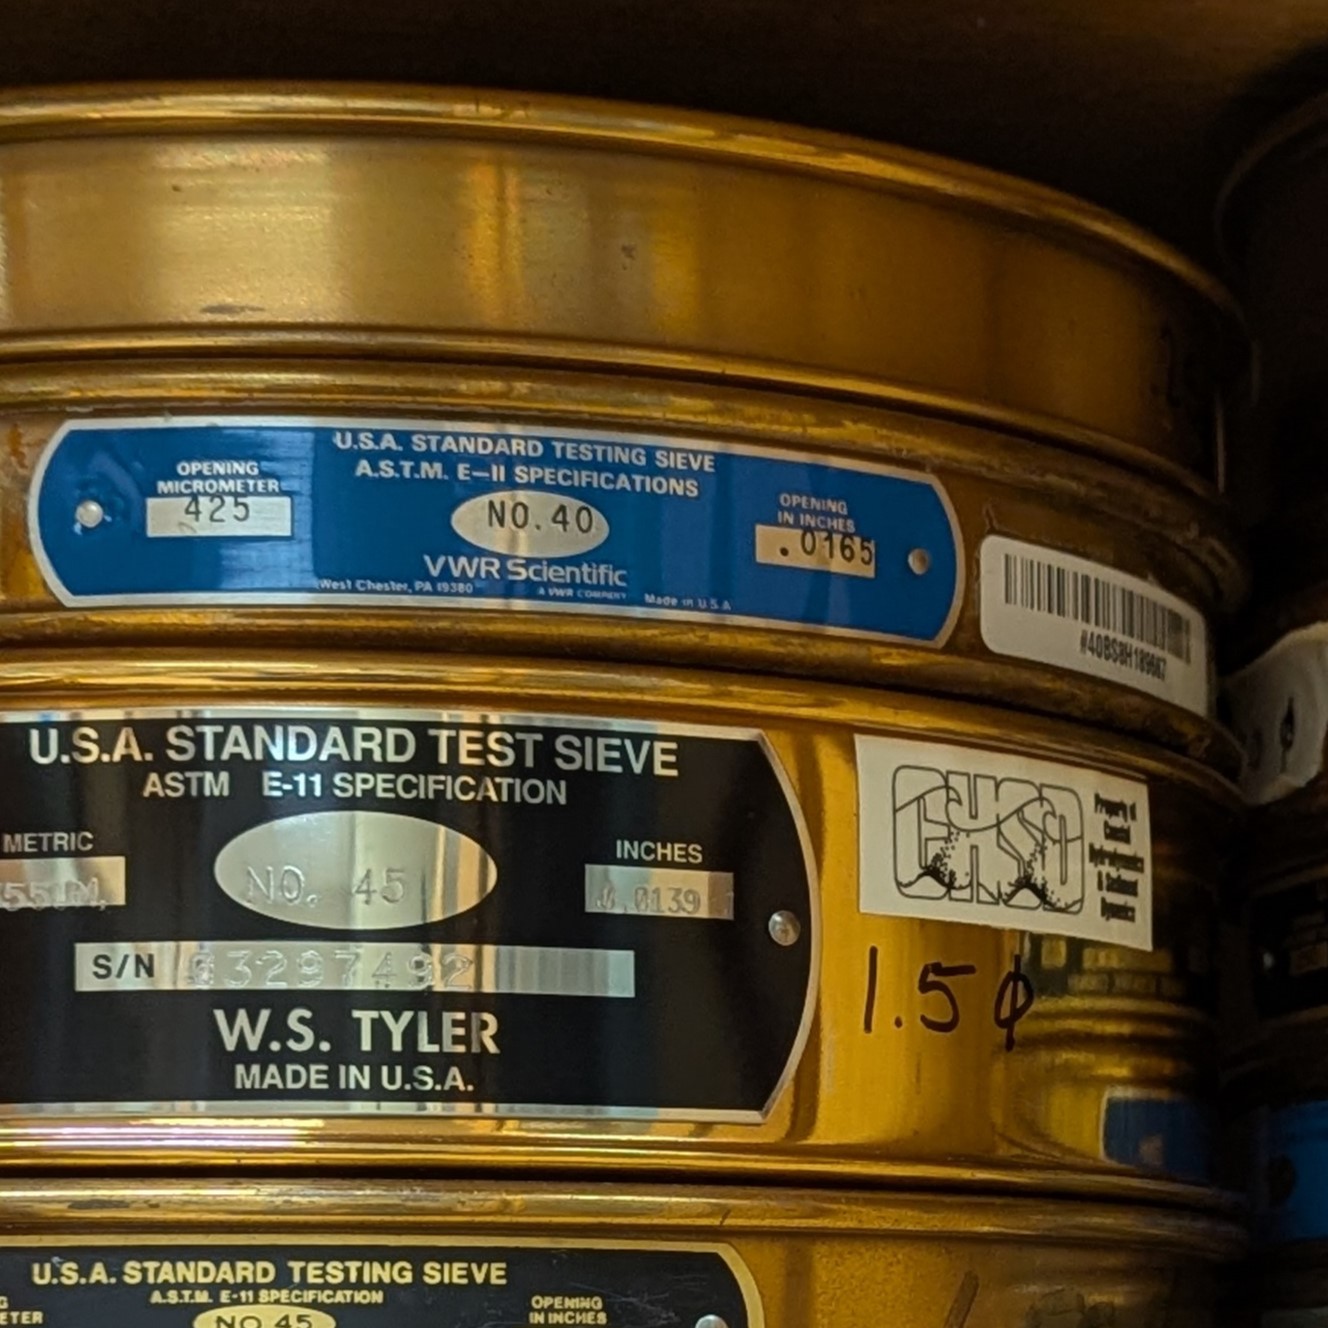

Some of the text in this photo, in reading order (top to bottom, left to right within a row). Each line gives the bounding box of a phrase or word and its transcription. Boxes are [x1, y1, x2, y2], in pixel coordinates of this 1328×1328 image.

[333, 432, 716, 473] U.S.A. STANDARD TESTING SIEVE
[176, 461, 260, 476] OPENING
[355, 460, 699, 498] A.S.T.M. SPECIFICATIONS
[156, 479, 280, 494] MICROMETER
[184, 497, 251, 524] 425
[779, 493, 849, 516] OPENING
[778, 510, 856, 535] IN INCHES
[423, 554, 628, 588] VWR Scientific
[414, 580, 433, 592] PA
[29, 725, 680, 778] U.S.A. STANDARD TEST SIEVE
[142, 771, 568, 806] ASTM E-11 SPECIFICATION
[2, 831, 95, 854] METRIC
[616, 839, 704, 864] INCHES
[245, 865, 411, 910] NO. 45
[92, 952, 156, 980] S/N
[213, 1007, 501, 1055] W.S. TYLER
[234, 1063, 475, 1093] MADE IN U.S.A.
[32, 1260, 508, 1287] U.S.A. STANDARD TESTING SIEVE
[258, 1289, 385, 1305] SPECIFICATION
[531, 1295, 604, 1311] OPENING
[528, 1311, 608, 1326] IN INCHES
